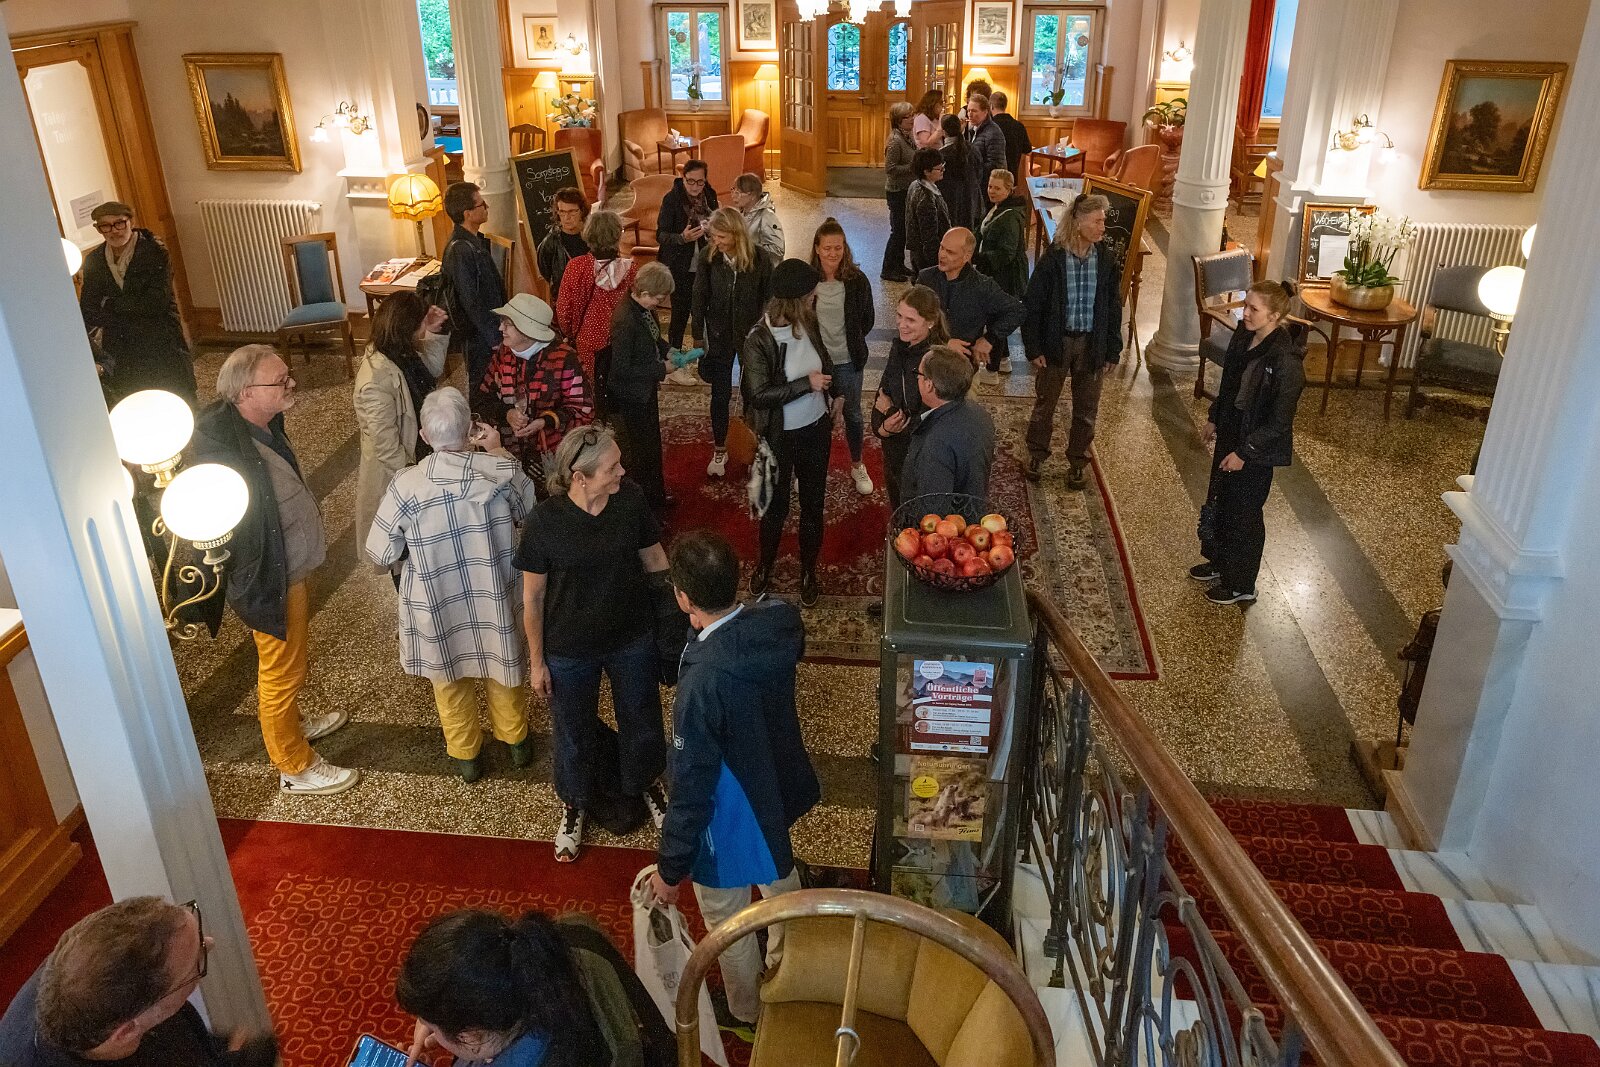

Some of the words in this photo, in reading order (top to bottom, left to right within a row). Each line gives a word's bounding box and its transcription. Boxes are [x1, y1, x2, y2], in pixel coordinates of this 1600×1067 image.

[526, 164, 563, 181] Samstag
[926, 682, 979, 693] Öffentliche
[932, 692, 973, 702] Vorträge
